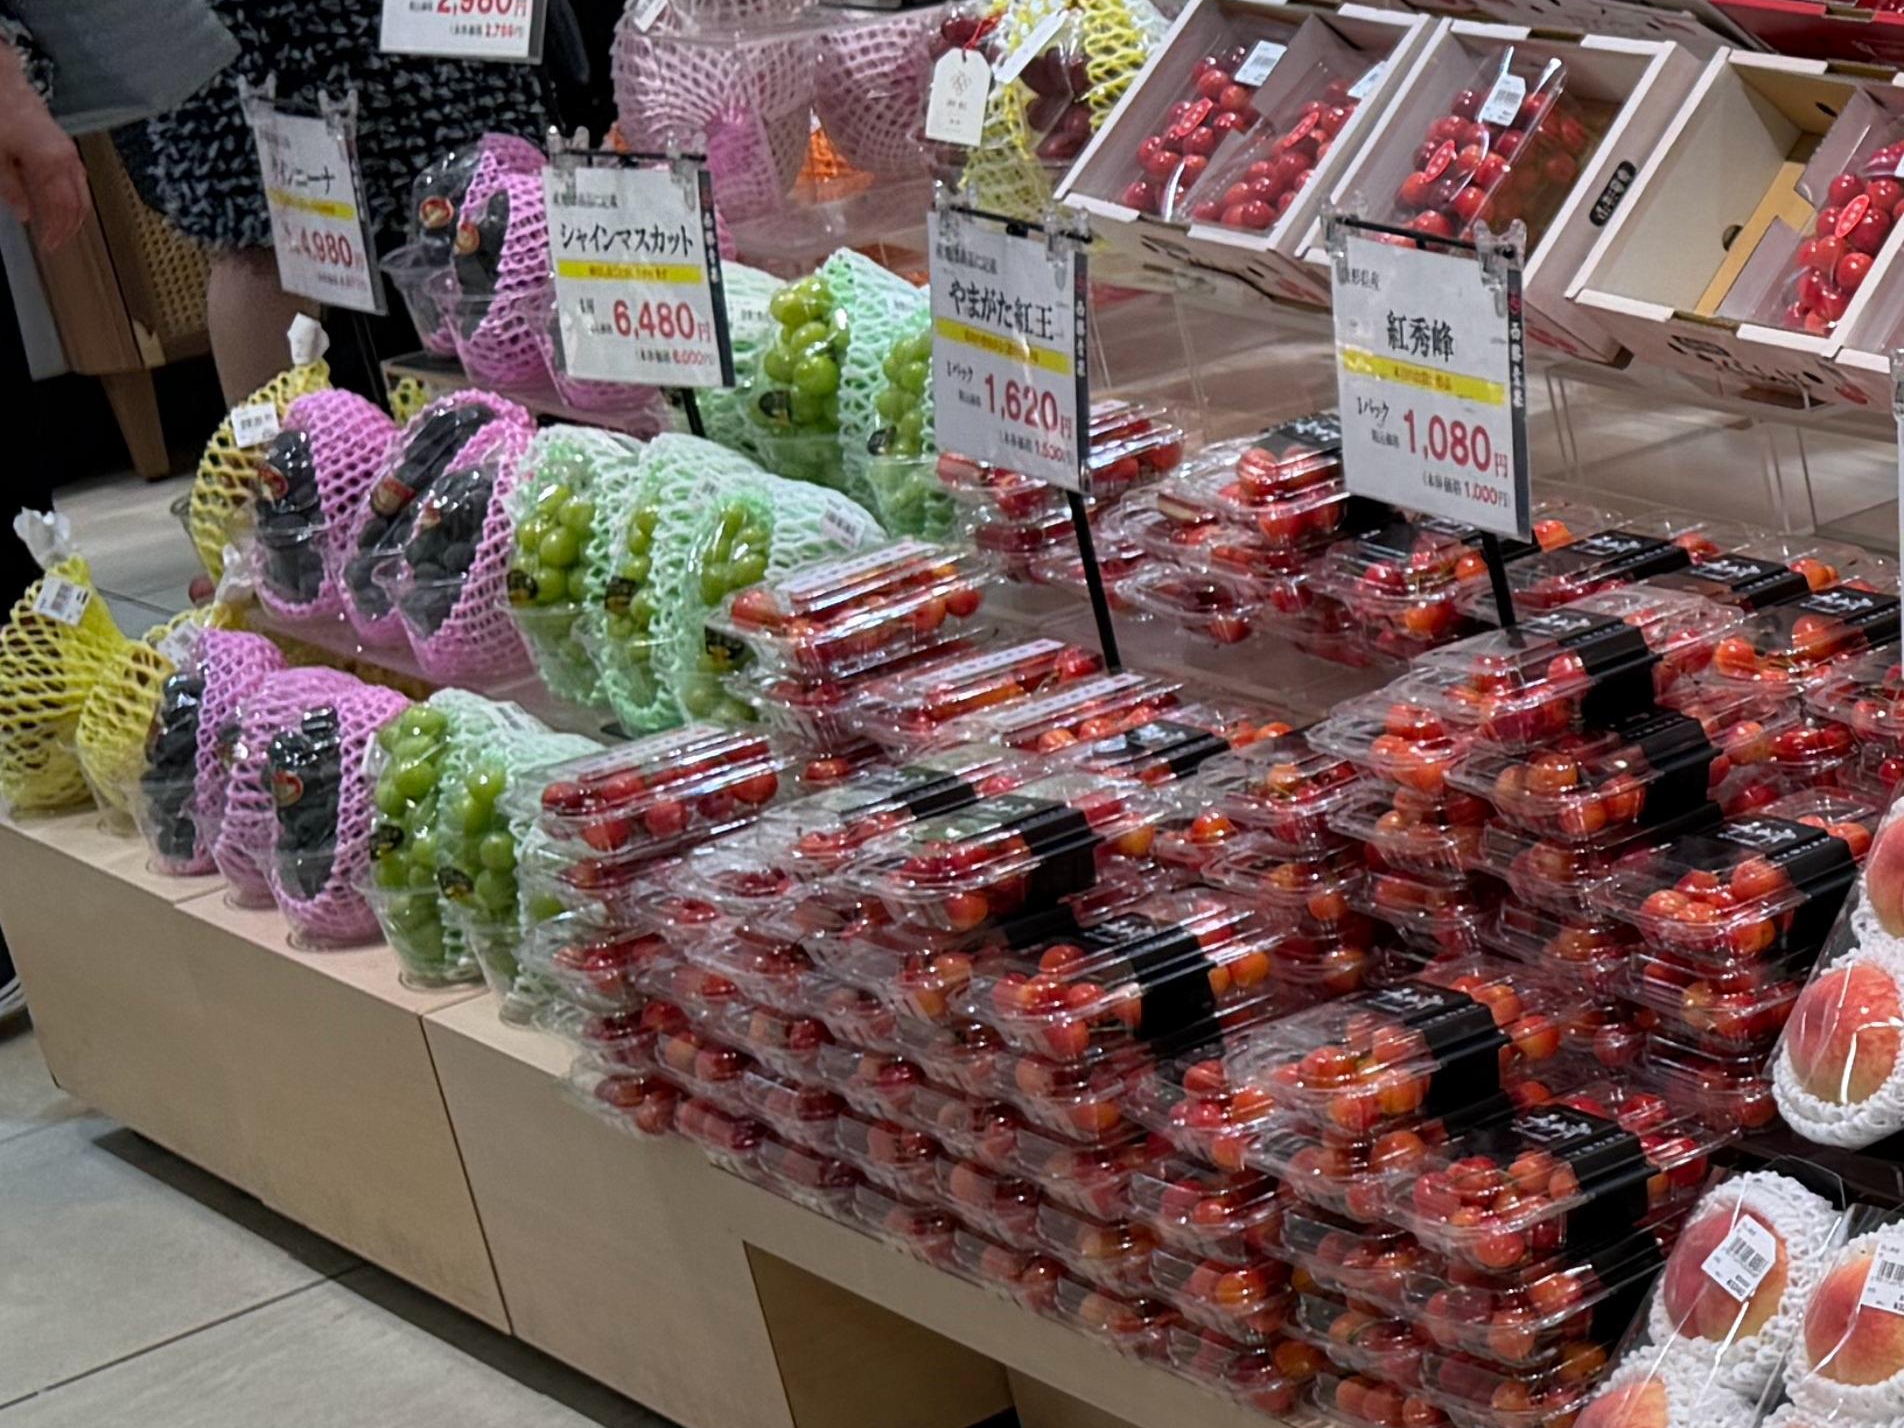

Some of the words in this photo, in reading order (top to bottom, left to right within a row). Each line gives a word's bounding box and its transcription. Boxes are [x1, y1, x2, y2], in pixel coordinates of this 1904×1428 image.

[559, 223, 695, 258] シャインマスカット
[612, 299, 712, 341] 6,480円
[948, 279, 1054, 343] やまがた紅王
[1387, 310, 1454, 361] 紅秀峰
[984, 371, 1074, 440] 1,620円
[1403, 407, 1510, 480] 1,080円
[1464, 480, 1511, 509] 1,000円)
